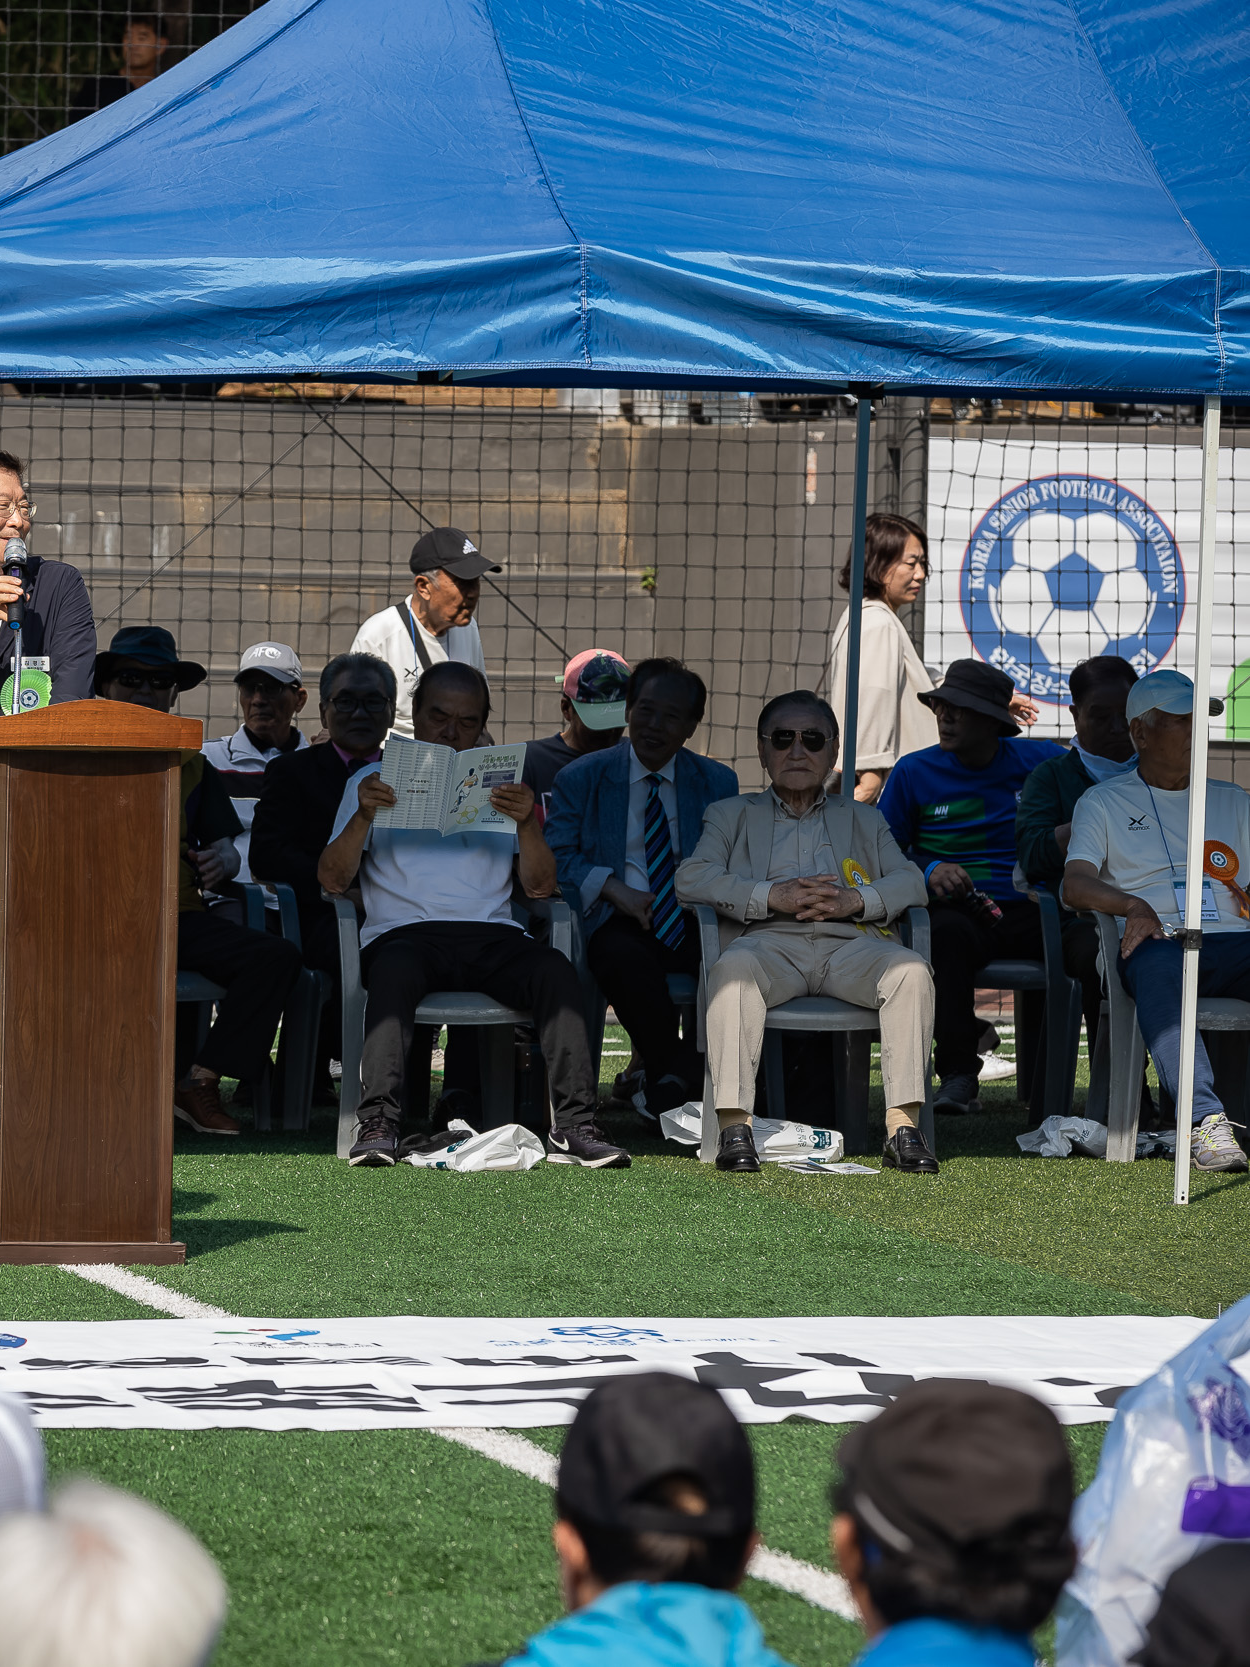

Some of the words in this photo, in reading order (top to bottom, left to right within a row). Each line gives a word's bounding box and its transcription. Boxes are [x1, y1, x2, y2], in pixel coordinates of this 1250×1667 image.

[968, 530, 1000, 590] KOREA
[988, 488, 1040, 532] SENIOR
[1039, 480, 1118, 506] FOOTBALL
